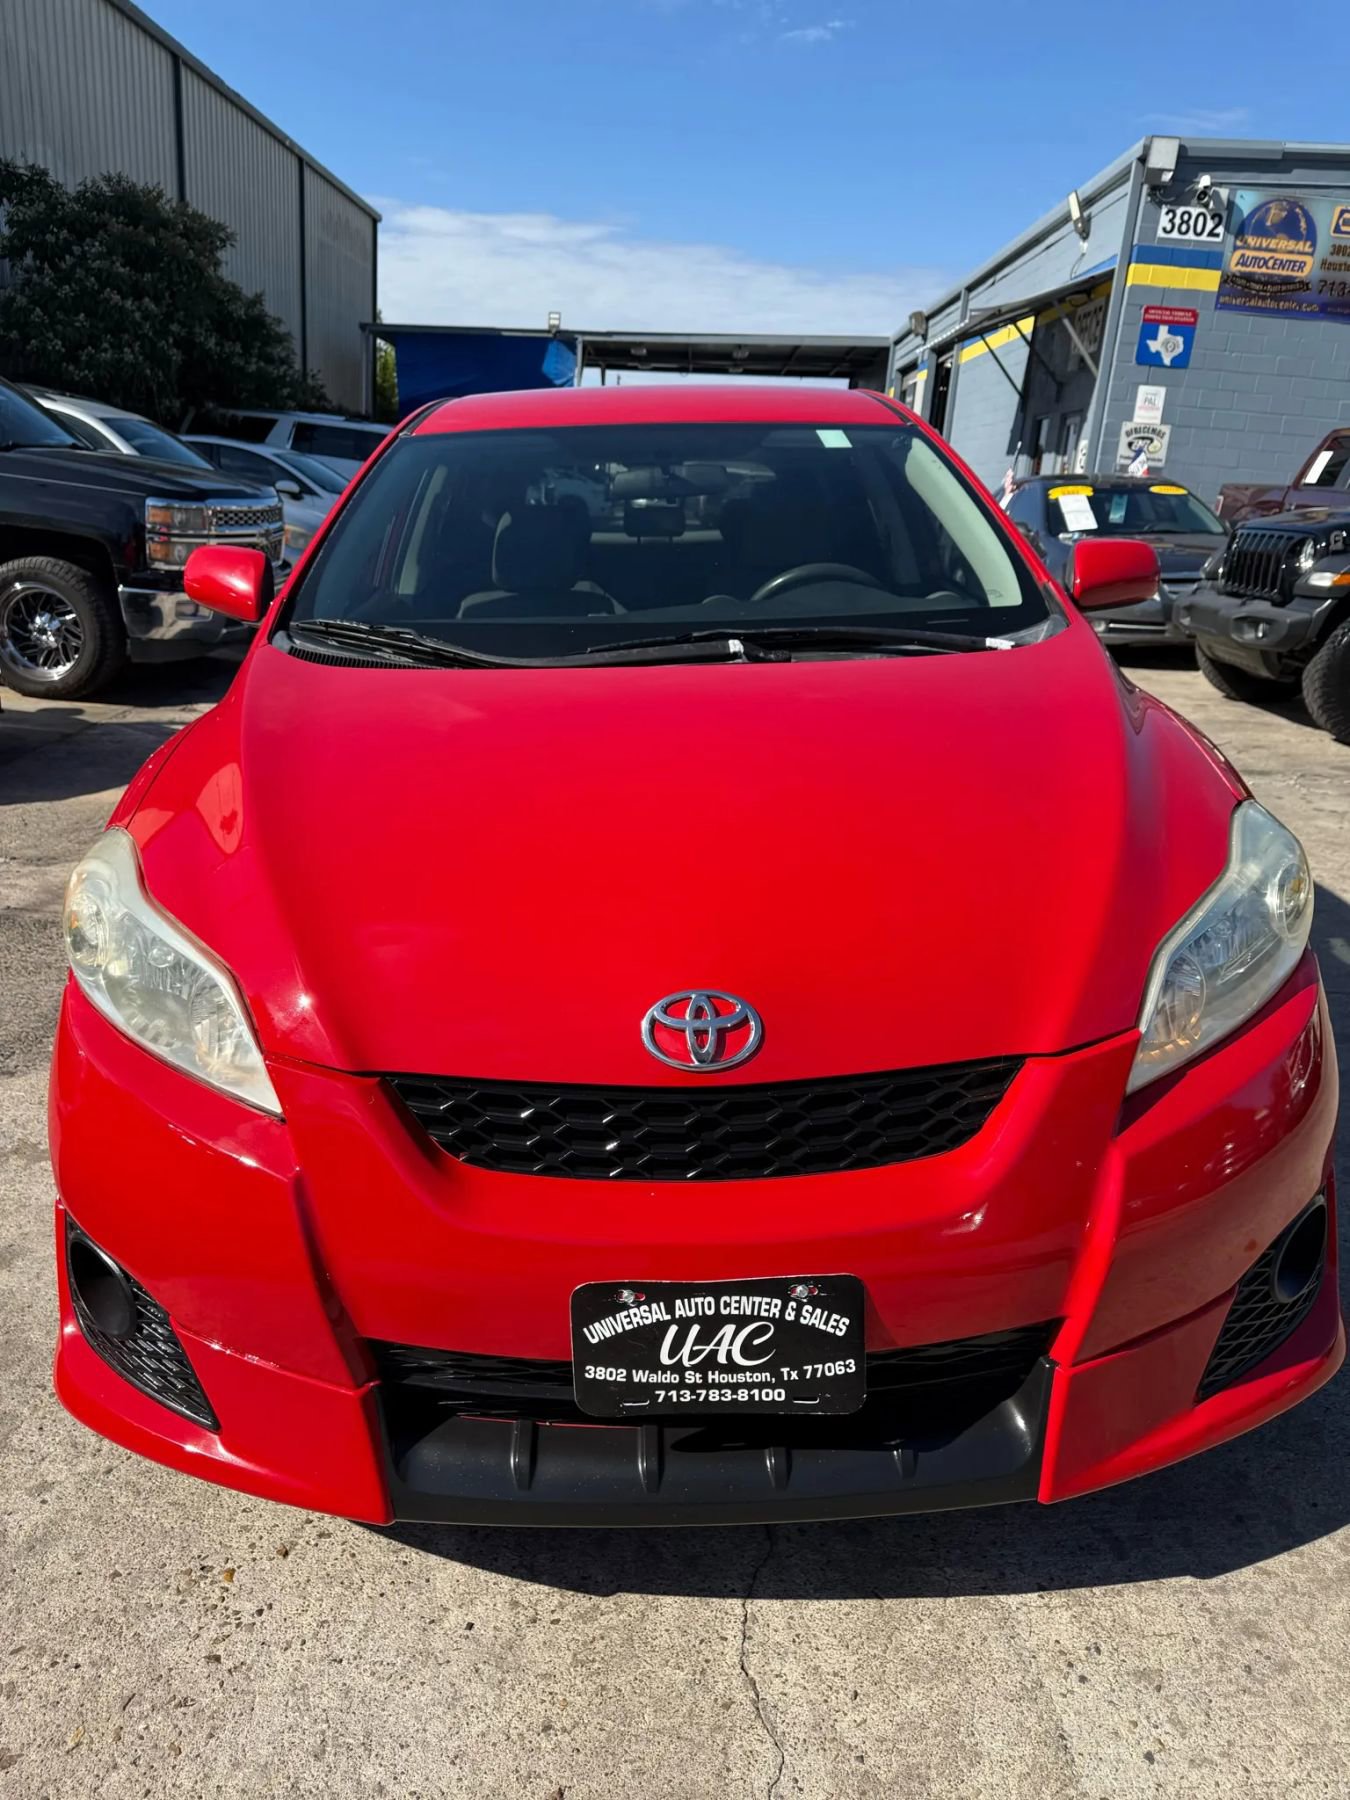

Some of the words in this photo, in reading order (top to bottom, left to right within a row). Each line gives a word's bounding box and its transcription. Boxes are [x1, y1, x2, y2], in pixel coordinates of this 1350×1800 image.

[1162, 209, 1223, 238] 3802
[1235, 235, 1314, 252] UNIVERSAL
[1235, 253, 1307, 273] AUTOCENTER
[583, 1302, 671, 1344] UNIVERSAL
[675, 1297, 715, 1318] AUTO
[720, 1296, 781, 1319] CENTER
[785, 1301, 797, 1320] &
[800, 1304, 850, 1337] SALES
[660, 1321, 776, 1367] UAC
[584, 1366, 627, 1382] 3802
[632, 1370, 680, 1383] Waldo
[684, 1371, 703, 1383] St
[708, 1370, 776, 1384] Houston,
[780, 1367, 799, 1381] Tx
[803, 1359, 856, 1379] 77063
[655, 1389, 786, 1402] 713-783-8100
